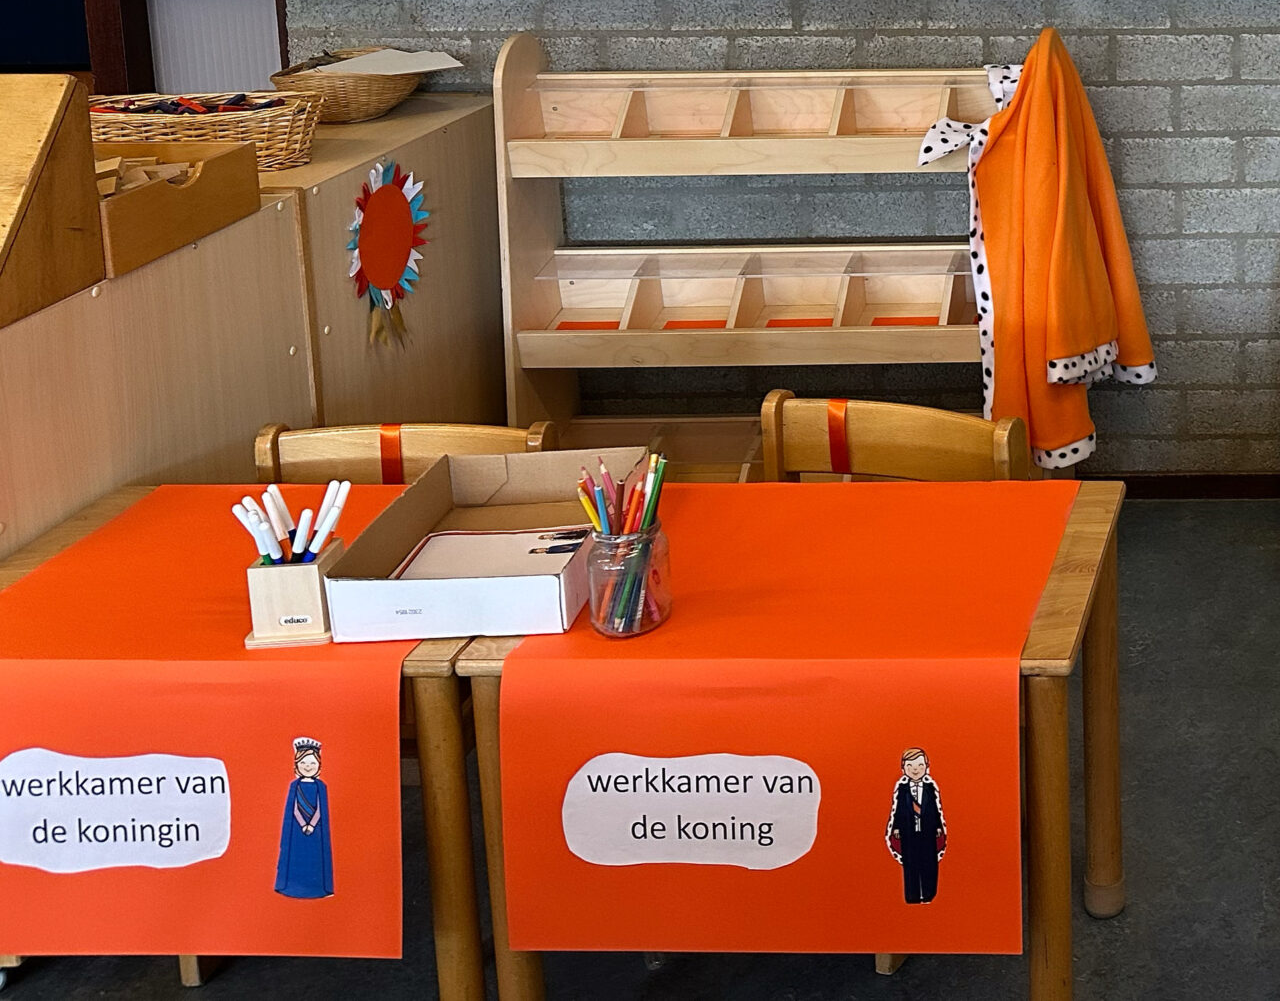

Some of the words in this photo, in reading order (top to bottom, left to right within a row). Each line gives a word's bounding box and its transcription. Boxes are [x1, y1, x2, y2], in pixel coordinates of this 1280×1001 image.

[1, 770, 167, 797] werkkamer
[175, 774, 226, 795] van
[586, 767, 754, 794] werkkamer
[762, 773, 814, 794] van
[31, 818, 67, 844] de
[77, 817, 201, 847] koningin
[630, 814, 667, 840] de
[677, 814, 774, 846] koning
